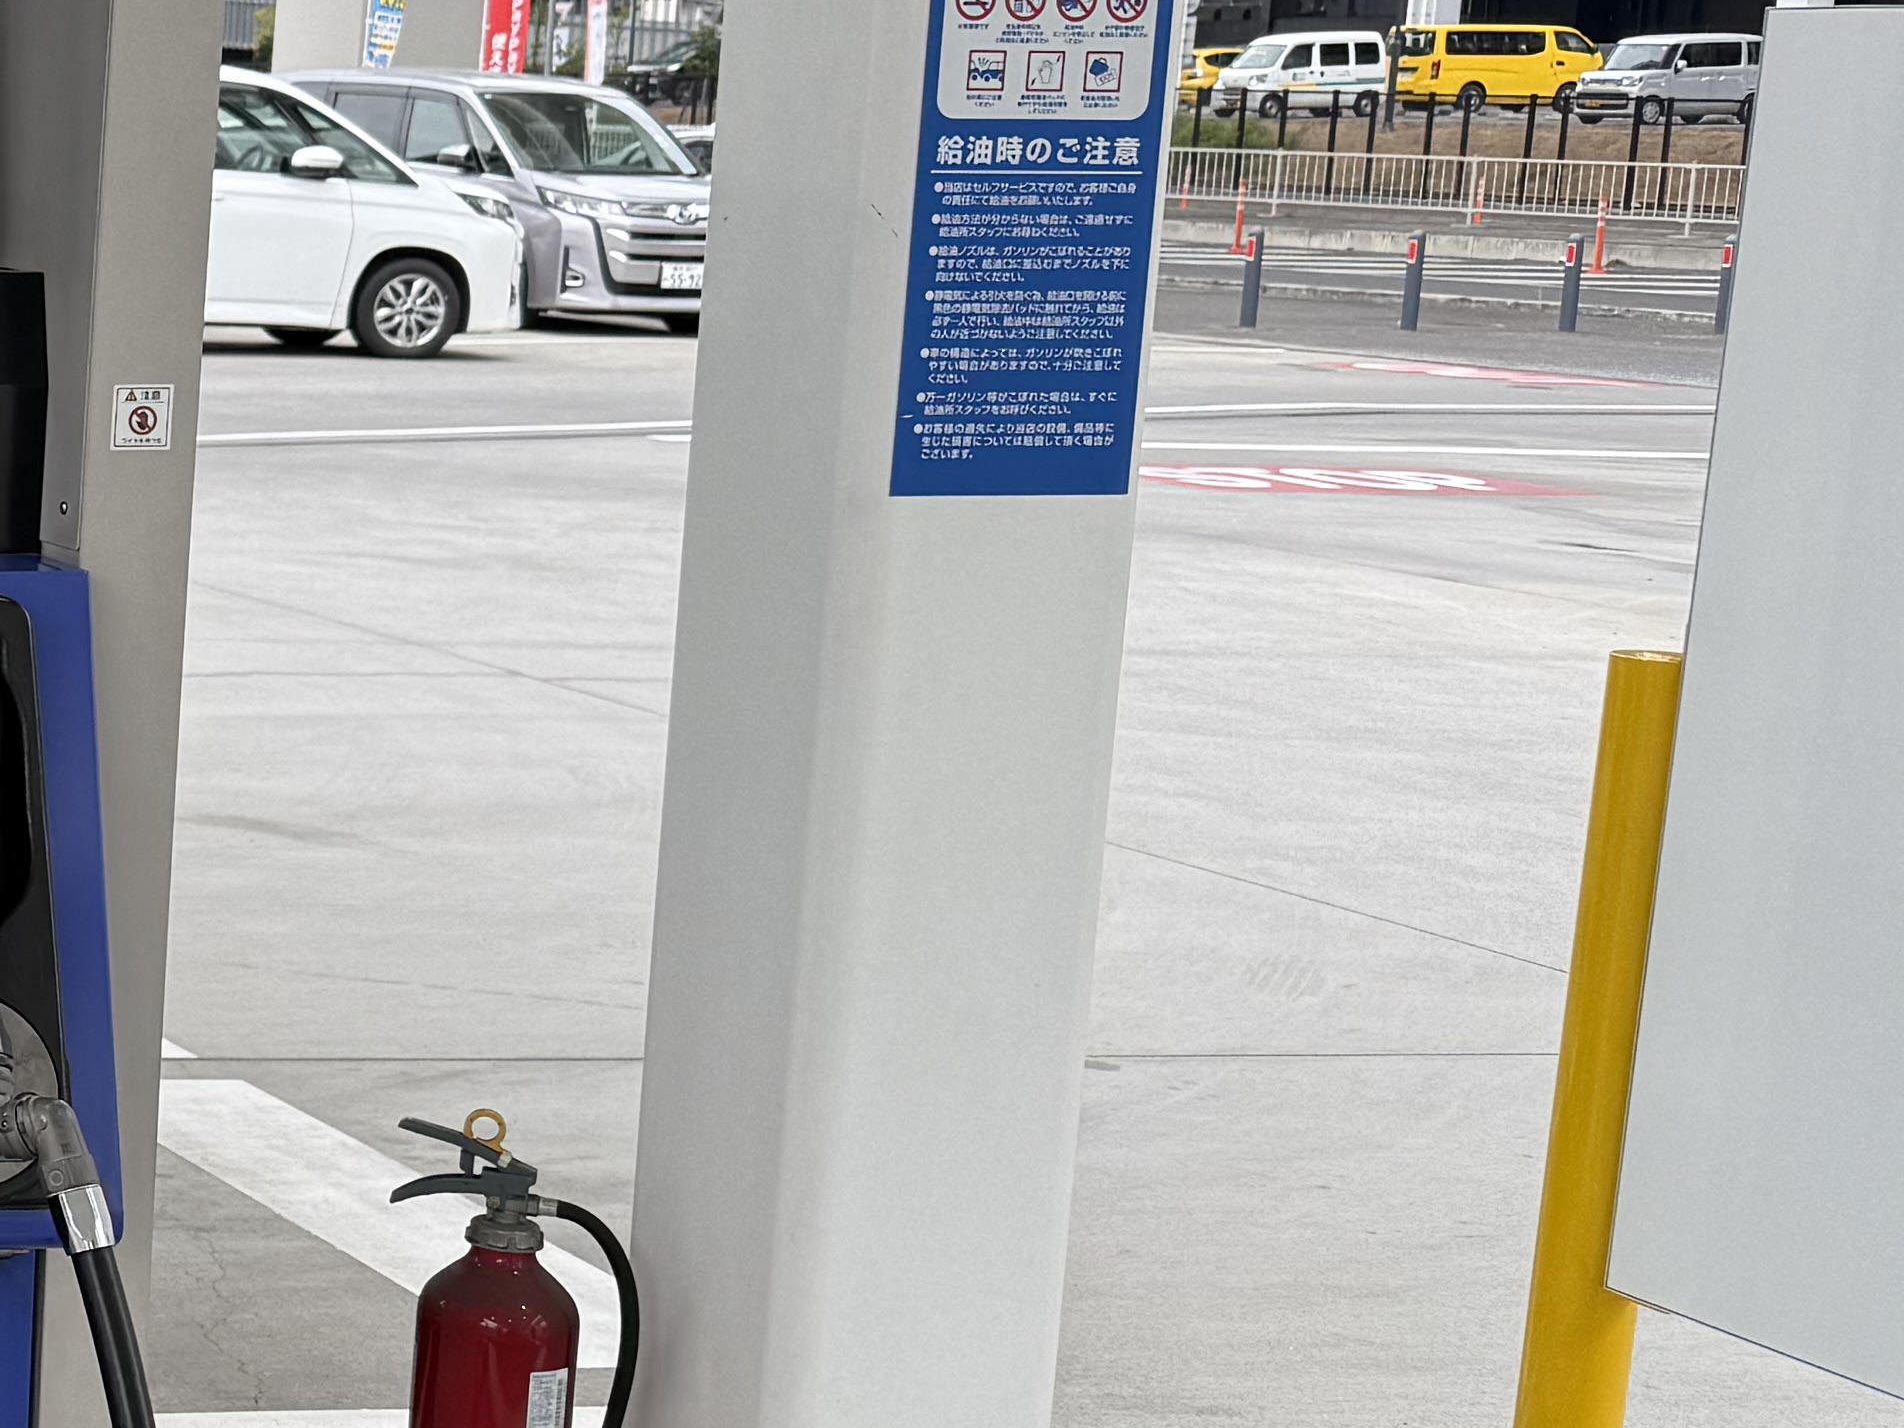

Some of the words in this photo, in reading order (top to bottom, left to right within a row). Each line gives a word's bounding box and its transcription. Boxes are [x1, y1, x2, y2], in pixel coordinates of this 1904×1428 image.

[936, 135, 1141, 166] 給油時のご注意
